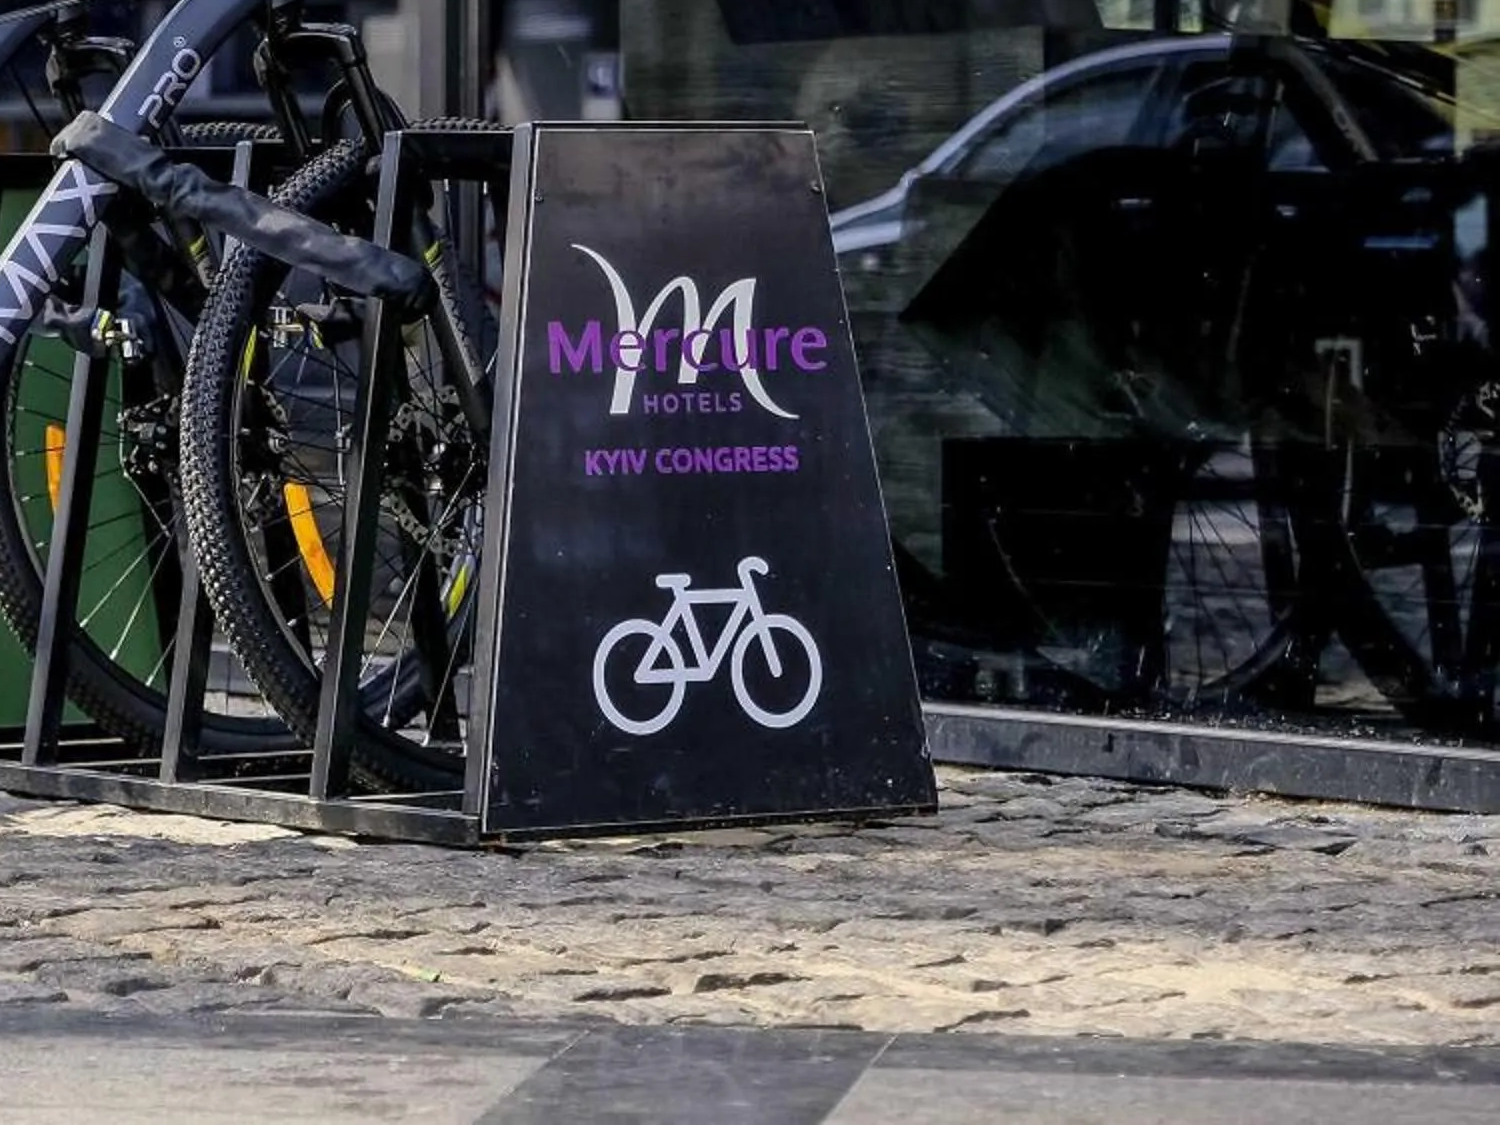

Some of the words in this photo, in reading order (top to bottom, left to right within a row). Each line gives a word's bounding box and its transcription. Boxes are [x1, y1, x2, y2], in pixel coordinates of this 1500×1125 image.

[547, 319, 829, 374] Mercure
[642, 391, 744, 416] HOTELS
[584, 448, 648, 477] KYIV
[655, 444, 801, 475] CONGRESS
